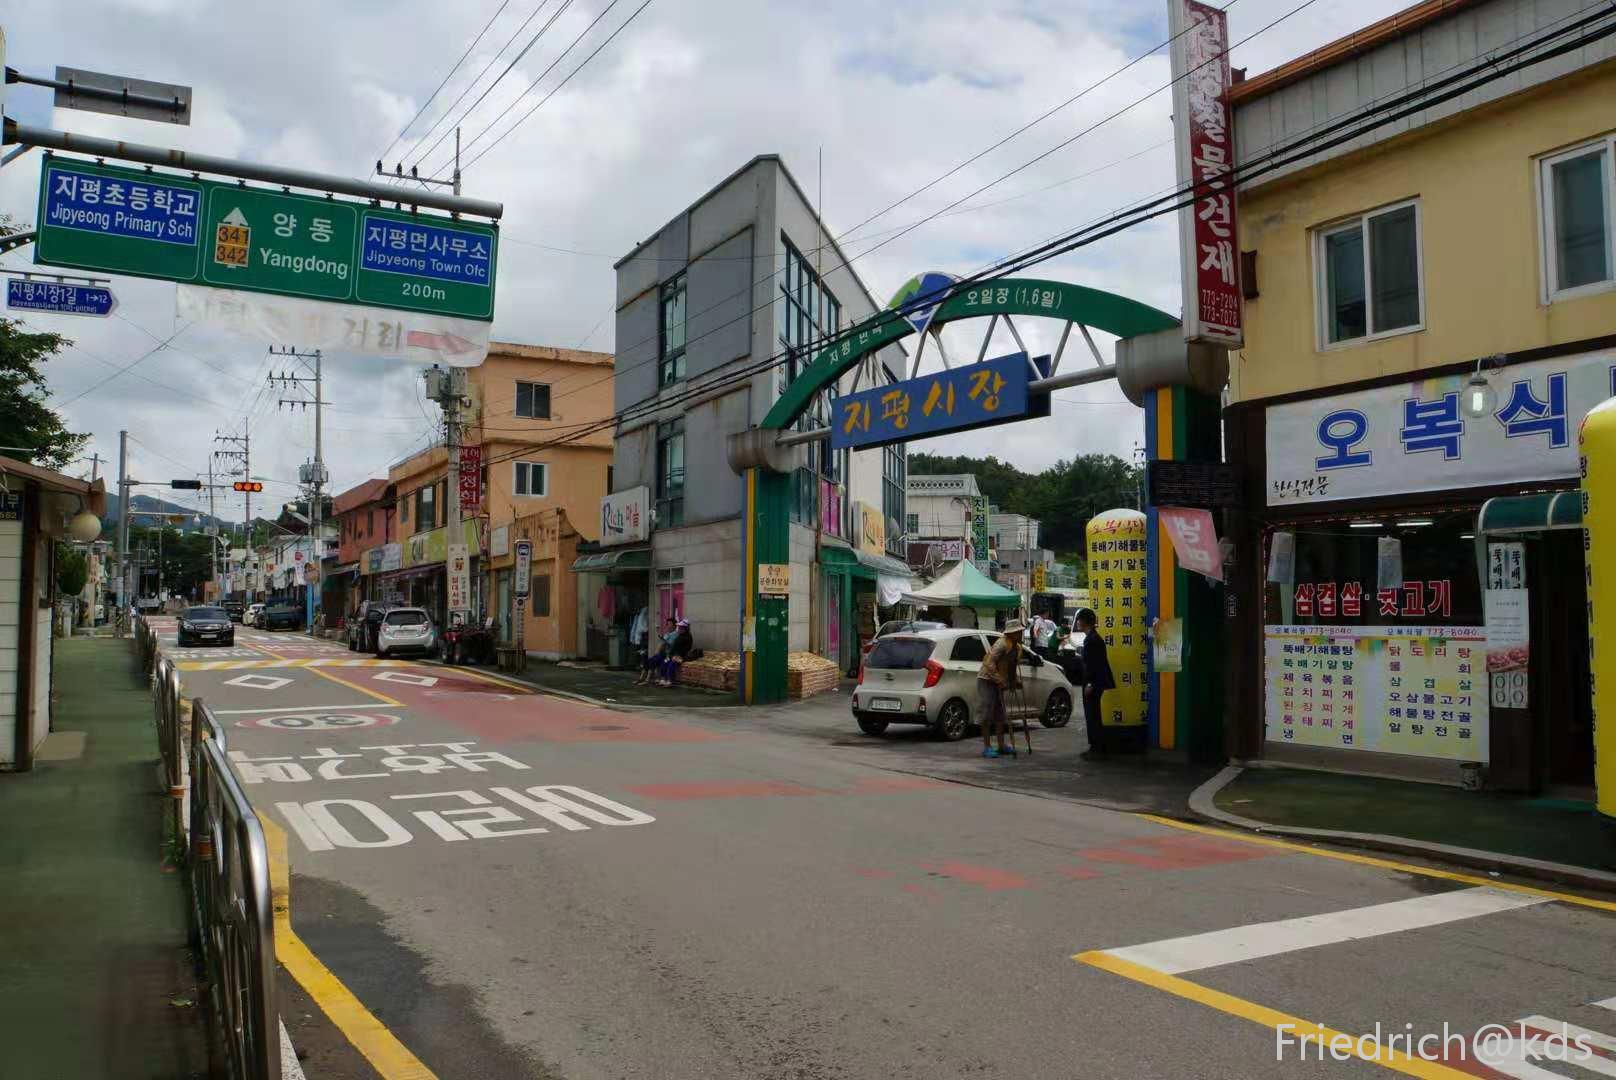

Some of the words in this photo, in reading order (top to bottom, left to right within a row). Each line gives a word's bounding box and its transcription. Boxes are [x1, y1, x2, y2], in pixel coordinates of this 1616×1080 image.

[55, 175, 195, 216] 지평초등학교
[51, 202, 110, 230] Jipyeong
[115, 211, 165, 237] Primary
[168, 219, 192, 238] Sch
[218, 226, 249, 243] 341
[272, 212, 334, 243] 양동
[216, 245, 248, 264] 342
[367, 226, 488, 260] 지평면사무소
[260, 247, 348, 280] Yangdong
[366, 249, 425, 270] Jipyeong
[429, 258, 461, 273] Town
[464, 263, 486, 277] Ofc
[10, 282, 77, 305] 지평시장1길
[401, 282, 446, 300] 200m
[965, 287, 1009, 306] 오일장
[842, 369, 1007, 433] 지평시장
[1315, 371, 1616, 472] 오복식
[1283, 644, 1353, 656] 뚝배기해물탕
[227, 741, 533, 784] 보호구역
[274, 783, 657, 852] 어린이
